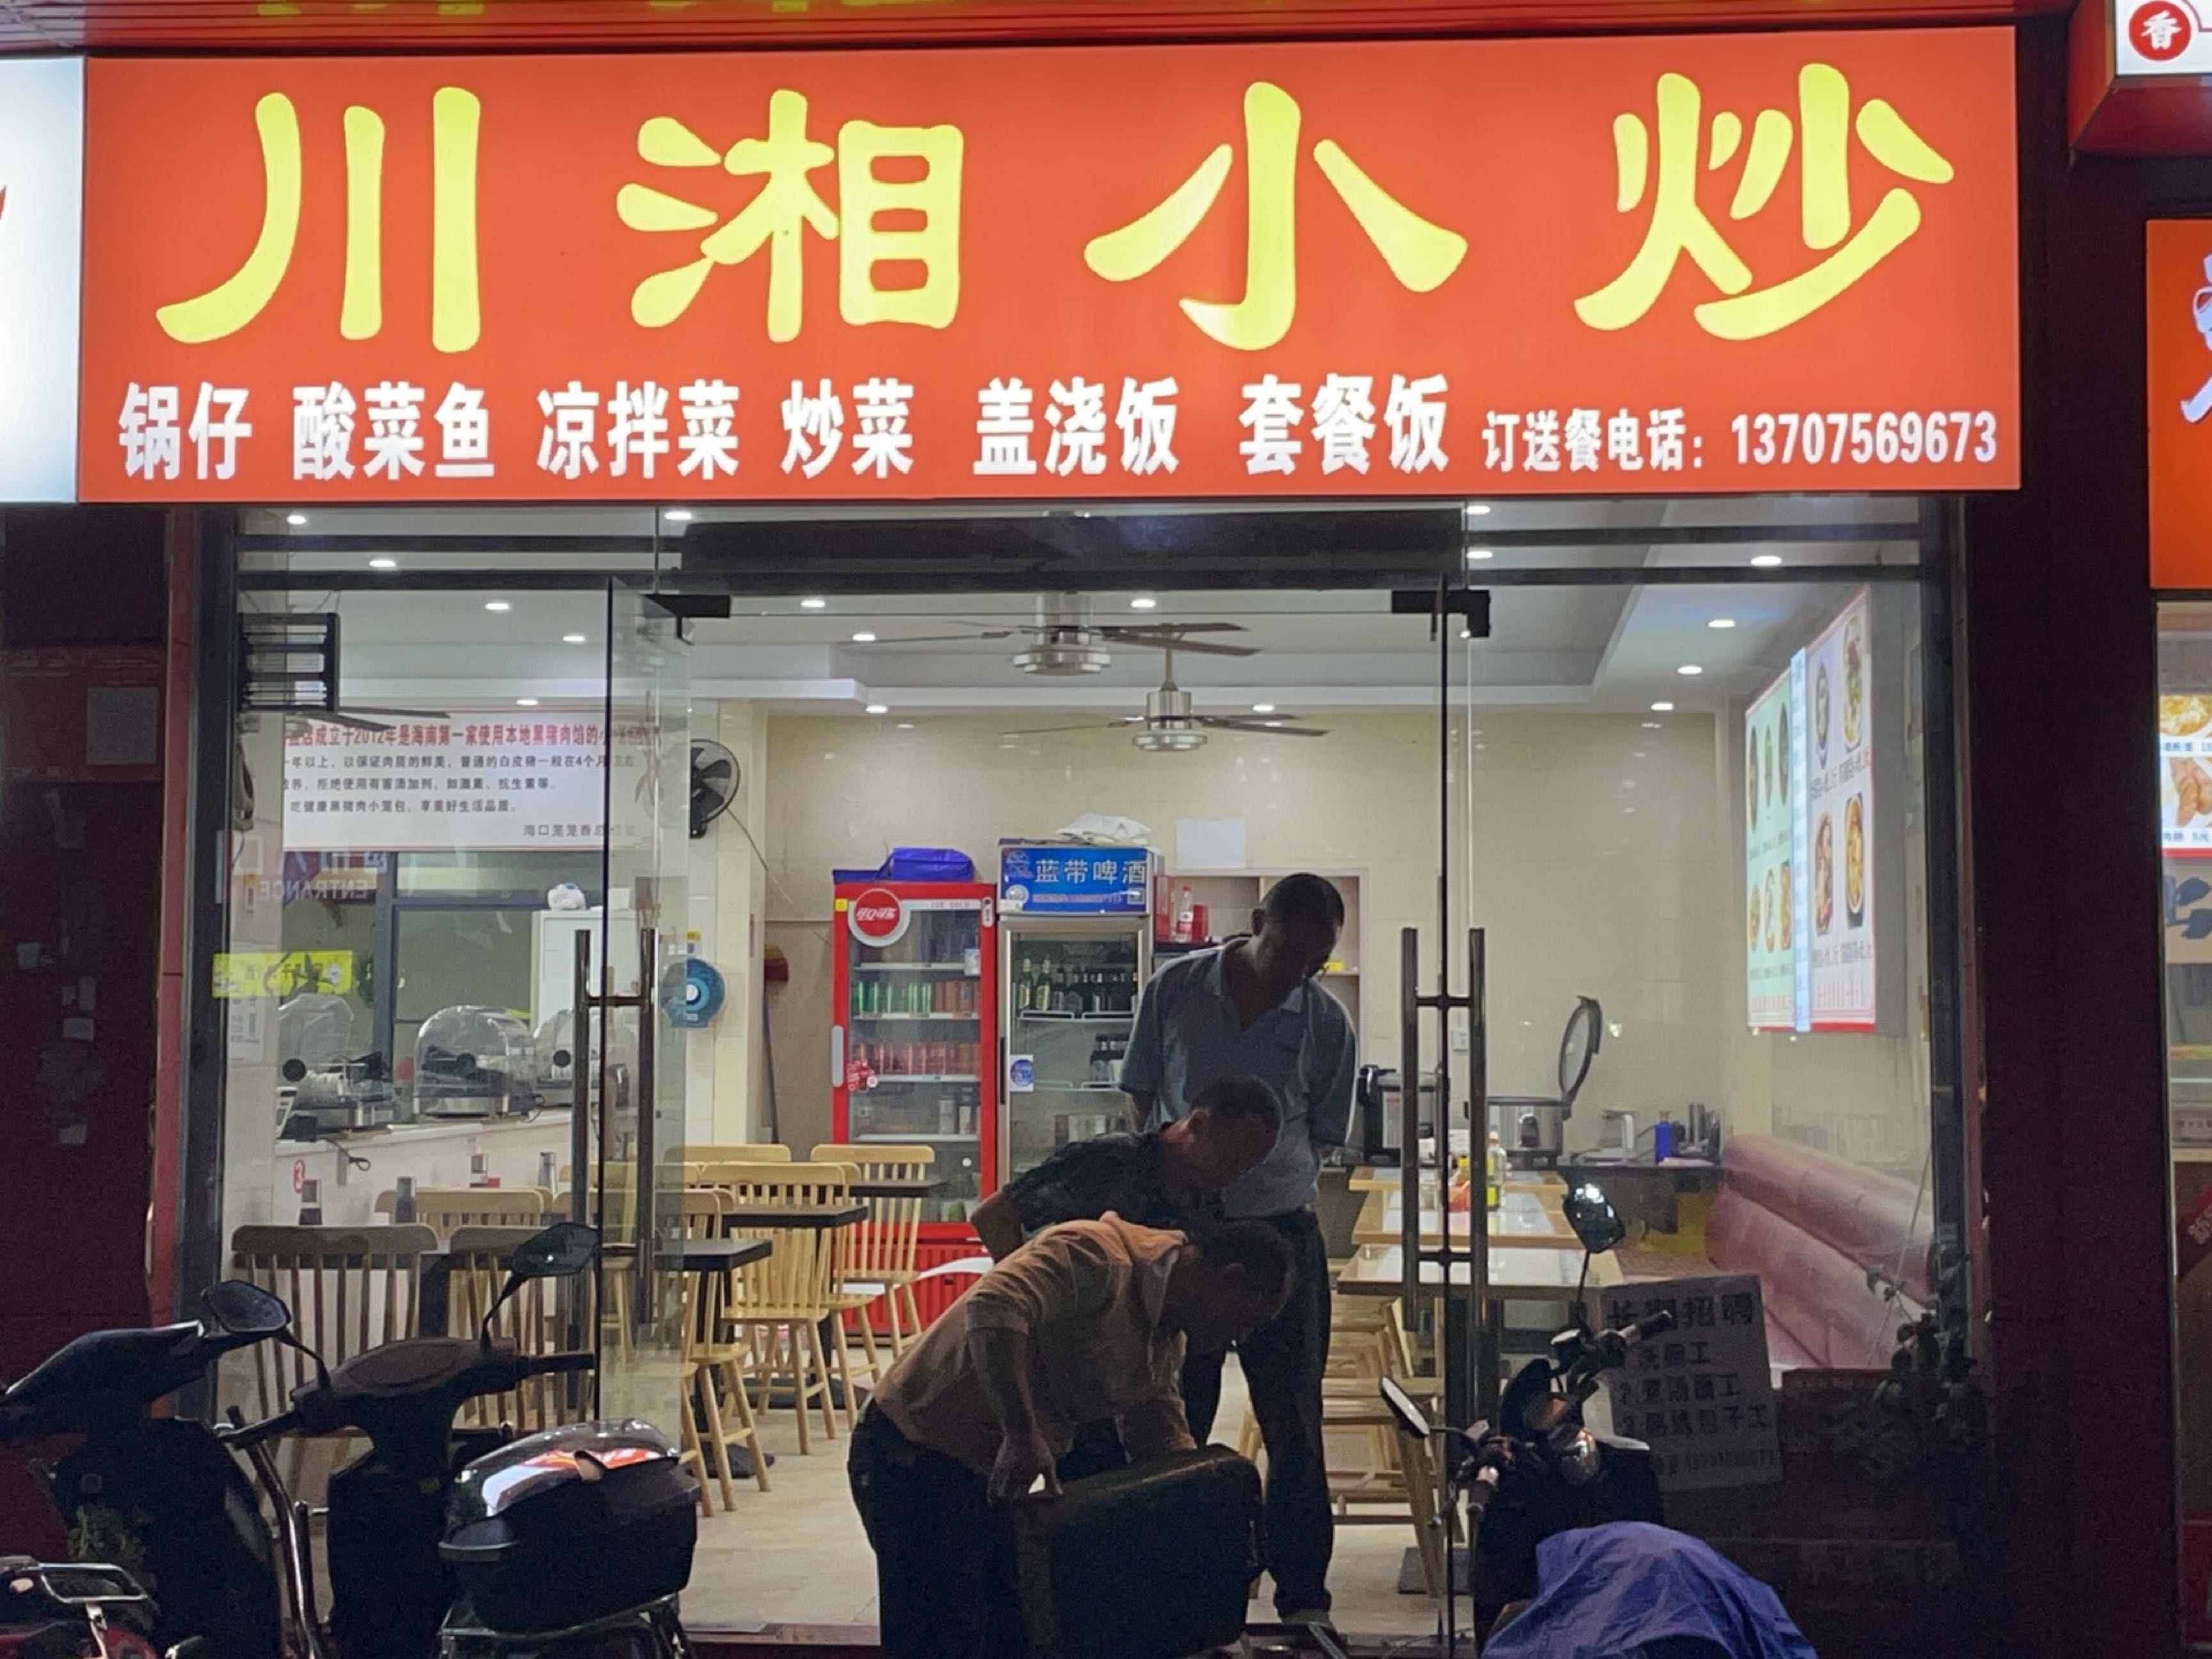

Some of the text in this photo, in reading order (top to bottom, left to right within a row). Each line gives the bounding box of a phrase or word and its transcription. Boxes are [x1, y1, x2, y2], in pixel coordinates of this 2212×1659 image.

[2141, 9, 2183, 51] 香
[156, 63, 1955, 354] 川湘小炒
[118, 381, 253, 481] 锅仔
[293, 380, 495, 481] 酸菜鱼
[536, 378, 740, 481] 凉拌菜
[780, 376, 915, 479] 炒菜
[972, 375, 1180, 477] 盖浇饭
[1238, 372, 1449, 476] 套餐饭
[1731, 410, 1997, 465] 13707569673
[1034, 858, 1147, 885] 蓝带啤酒
